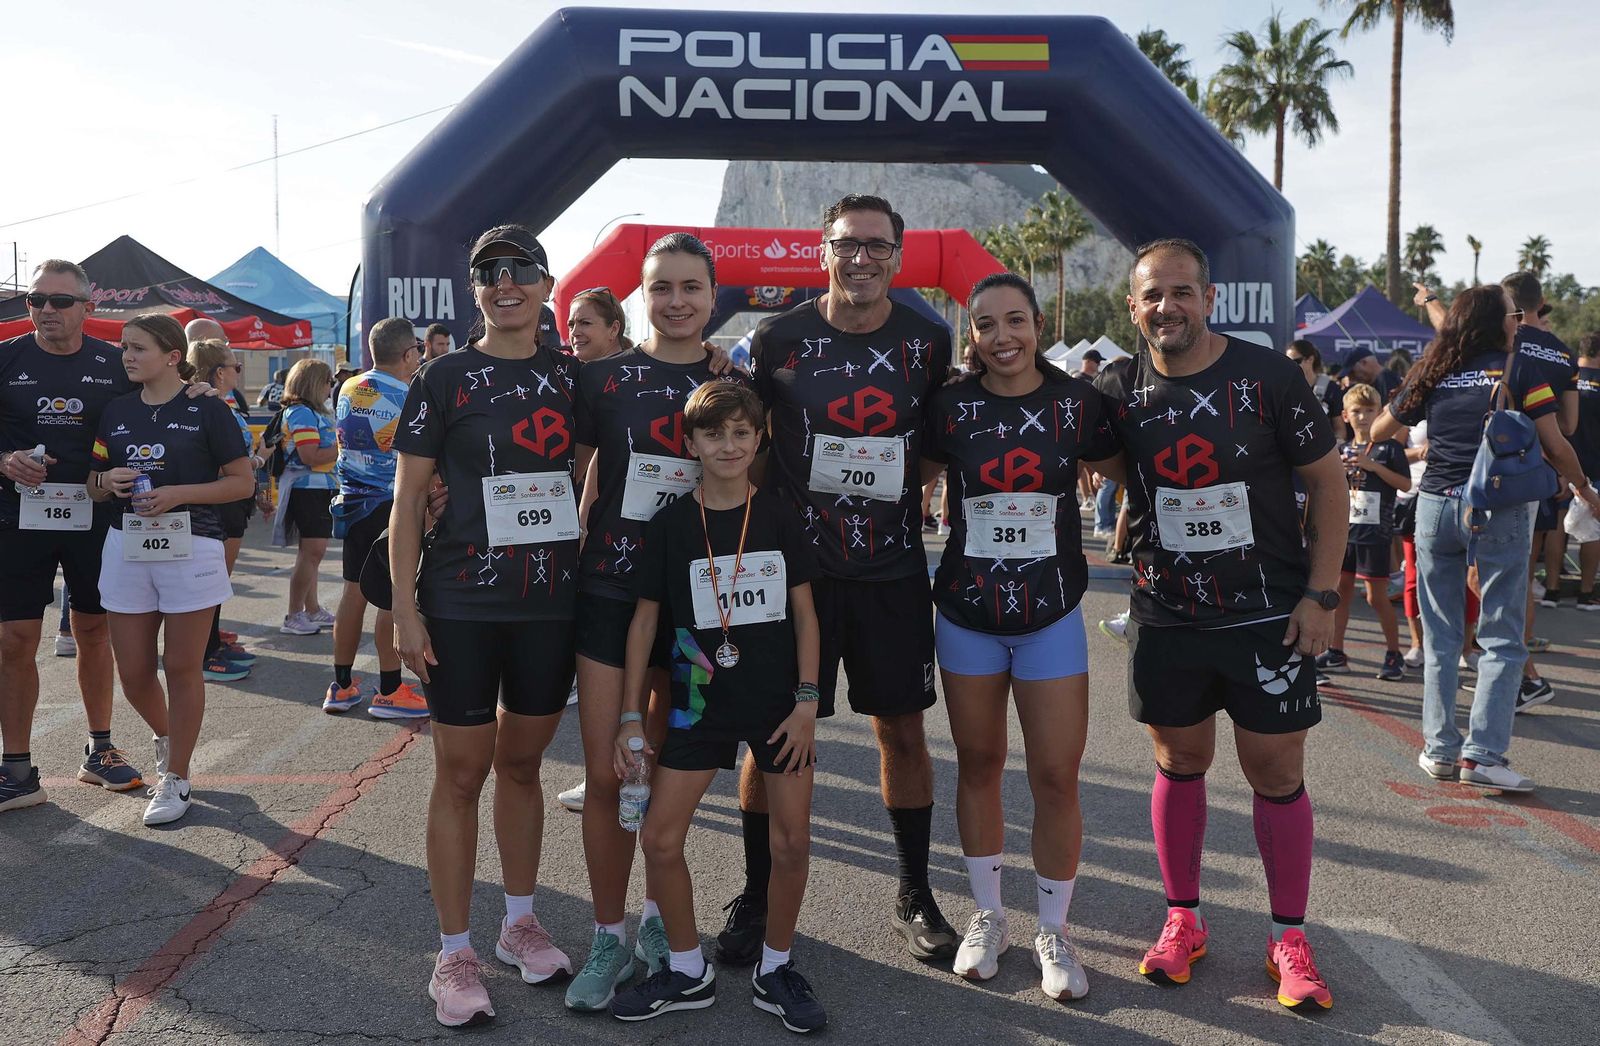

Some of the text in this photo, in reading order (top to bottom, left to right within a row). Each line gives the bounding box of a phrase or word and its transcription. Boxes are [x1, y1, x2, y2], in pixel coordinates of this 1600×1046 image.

[619, 76, 1048, 122] NACIONAL
[388, 277, 456, 320] RUTA
[1210, 282, 1275, 324] RUTA
[1334, 339, 1422, 353] POLICI
[1520, 342, 1563, 358] POLICIA
[1520, 349, 1571, 367] NACIONAL
[1436, 377, 1497, 389] ACIONAL
[1441, 369, 1487, 381] OLICIA
[180, 424, 200, 432] mupol
[841, 469, 876, 486] 700
[655, 491, 678, 507] 70
[44, 507, 72, 519] 186
[517, 508, 552, 527] 699
[992, 526, 1027, 543] 381
[1184, 520, 1223, 537] 388
[142, 538, 170, 550] 402
[718, 588, 766, 609] 1101
